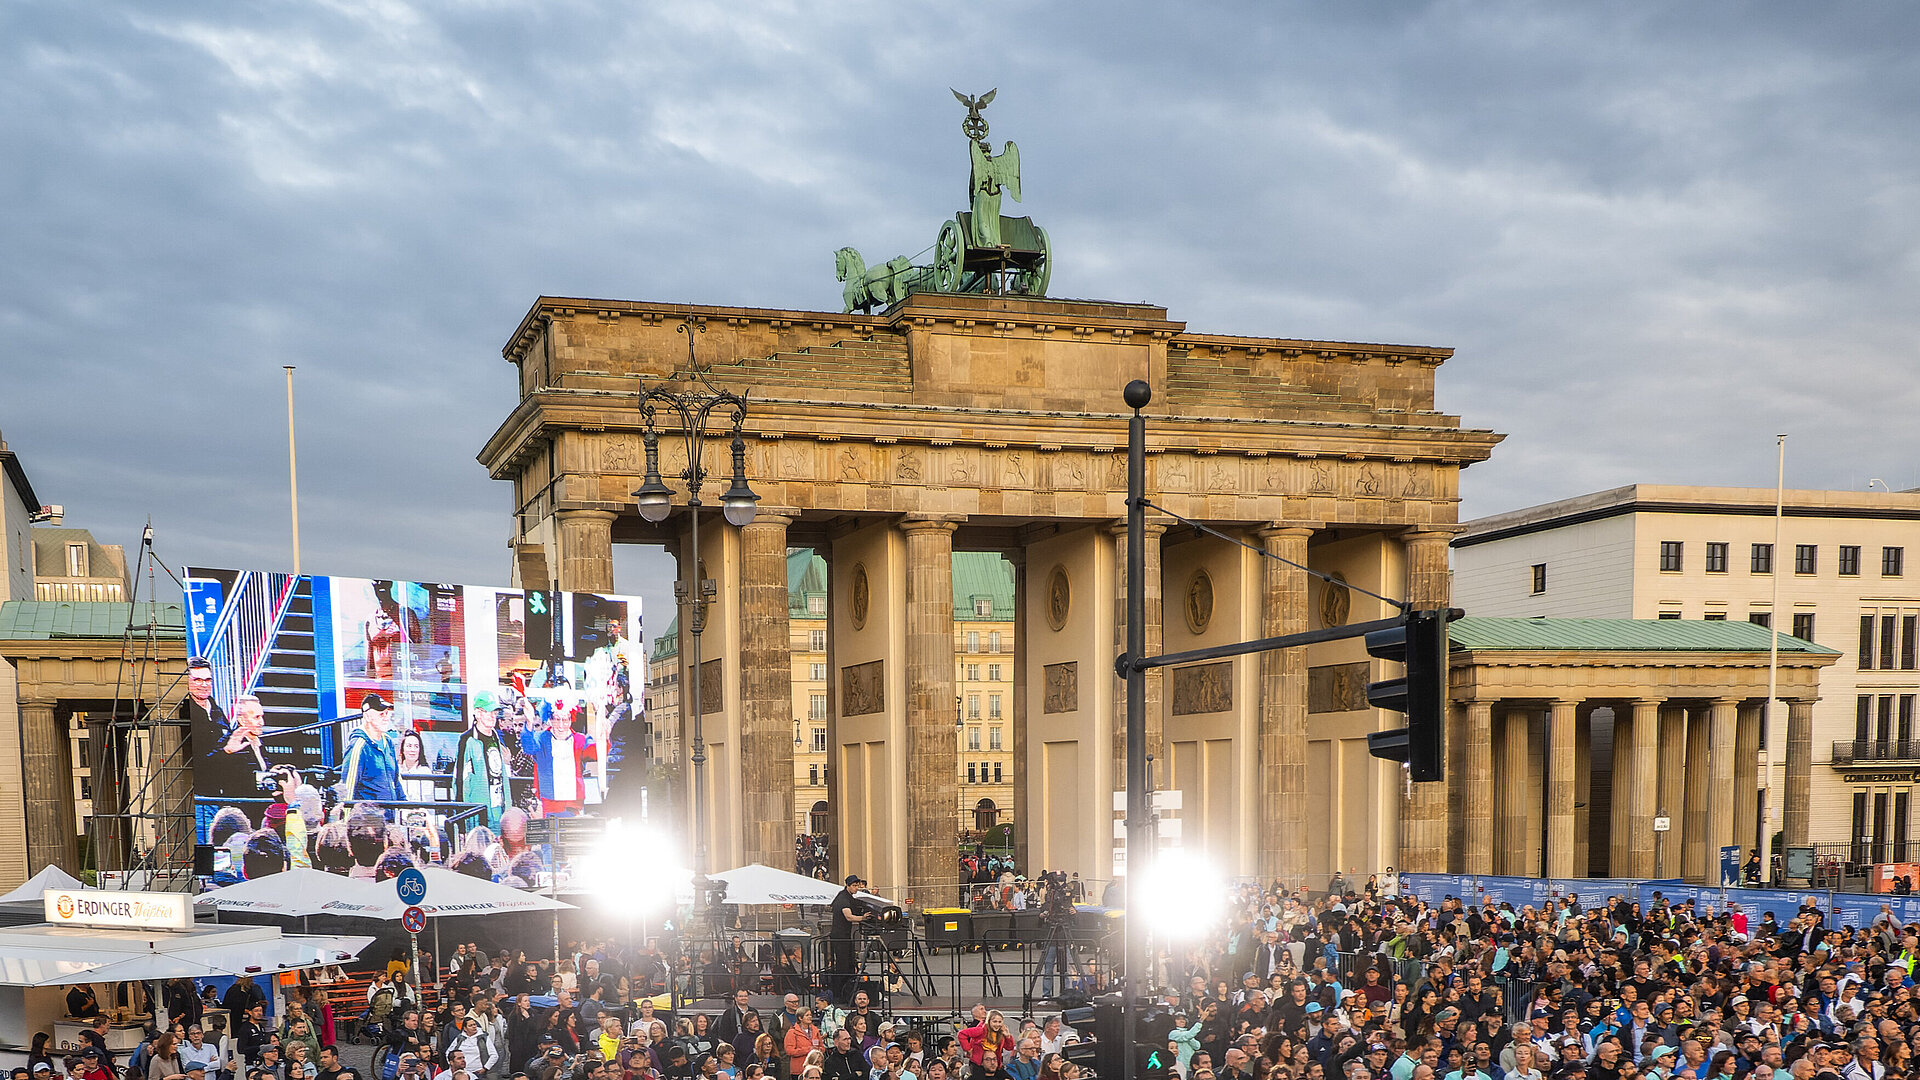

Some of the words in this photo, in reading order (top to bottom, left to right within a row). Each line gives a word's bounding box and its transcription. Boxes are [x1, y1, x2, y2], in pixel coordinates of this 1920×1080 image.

[1843, 774, 1912, 783] COMMERZBANK
[77, 899, 132, 918] ERDINGER
[437, 902, 496, 912] ERDINGER
